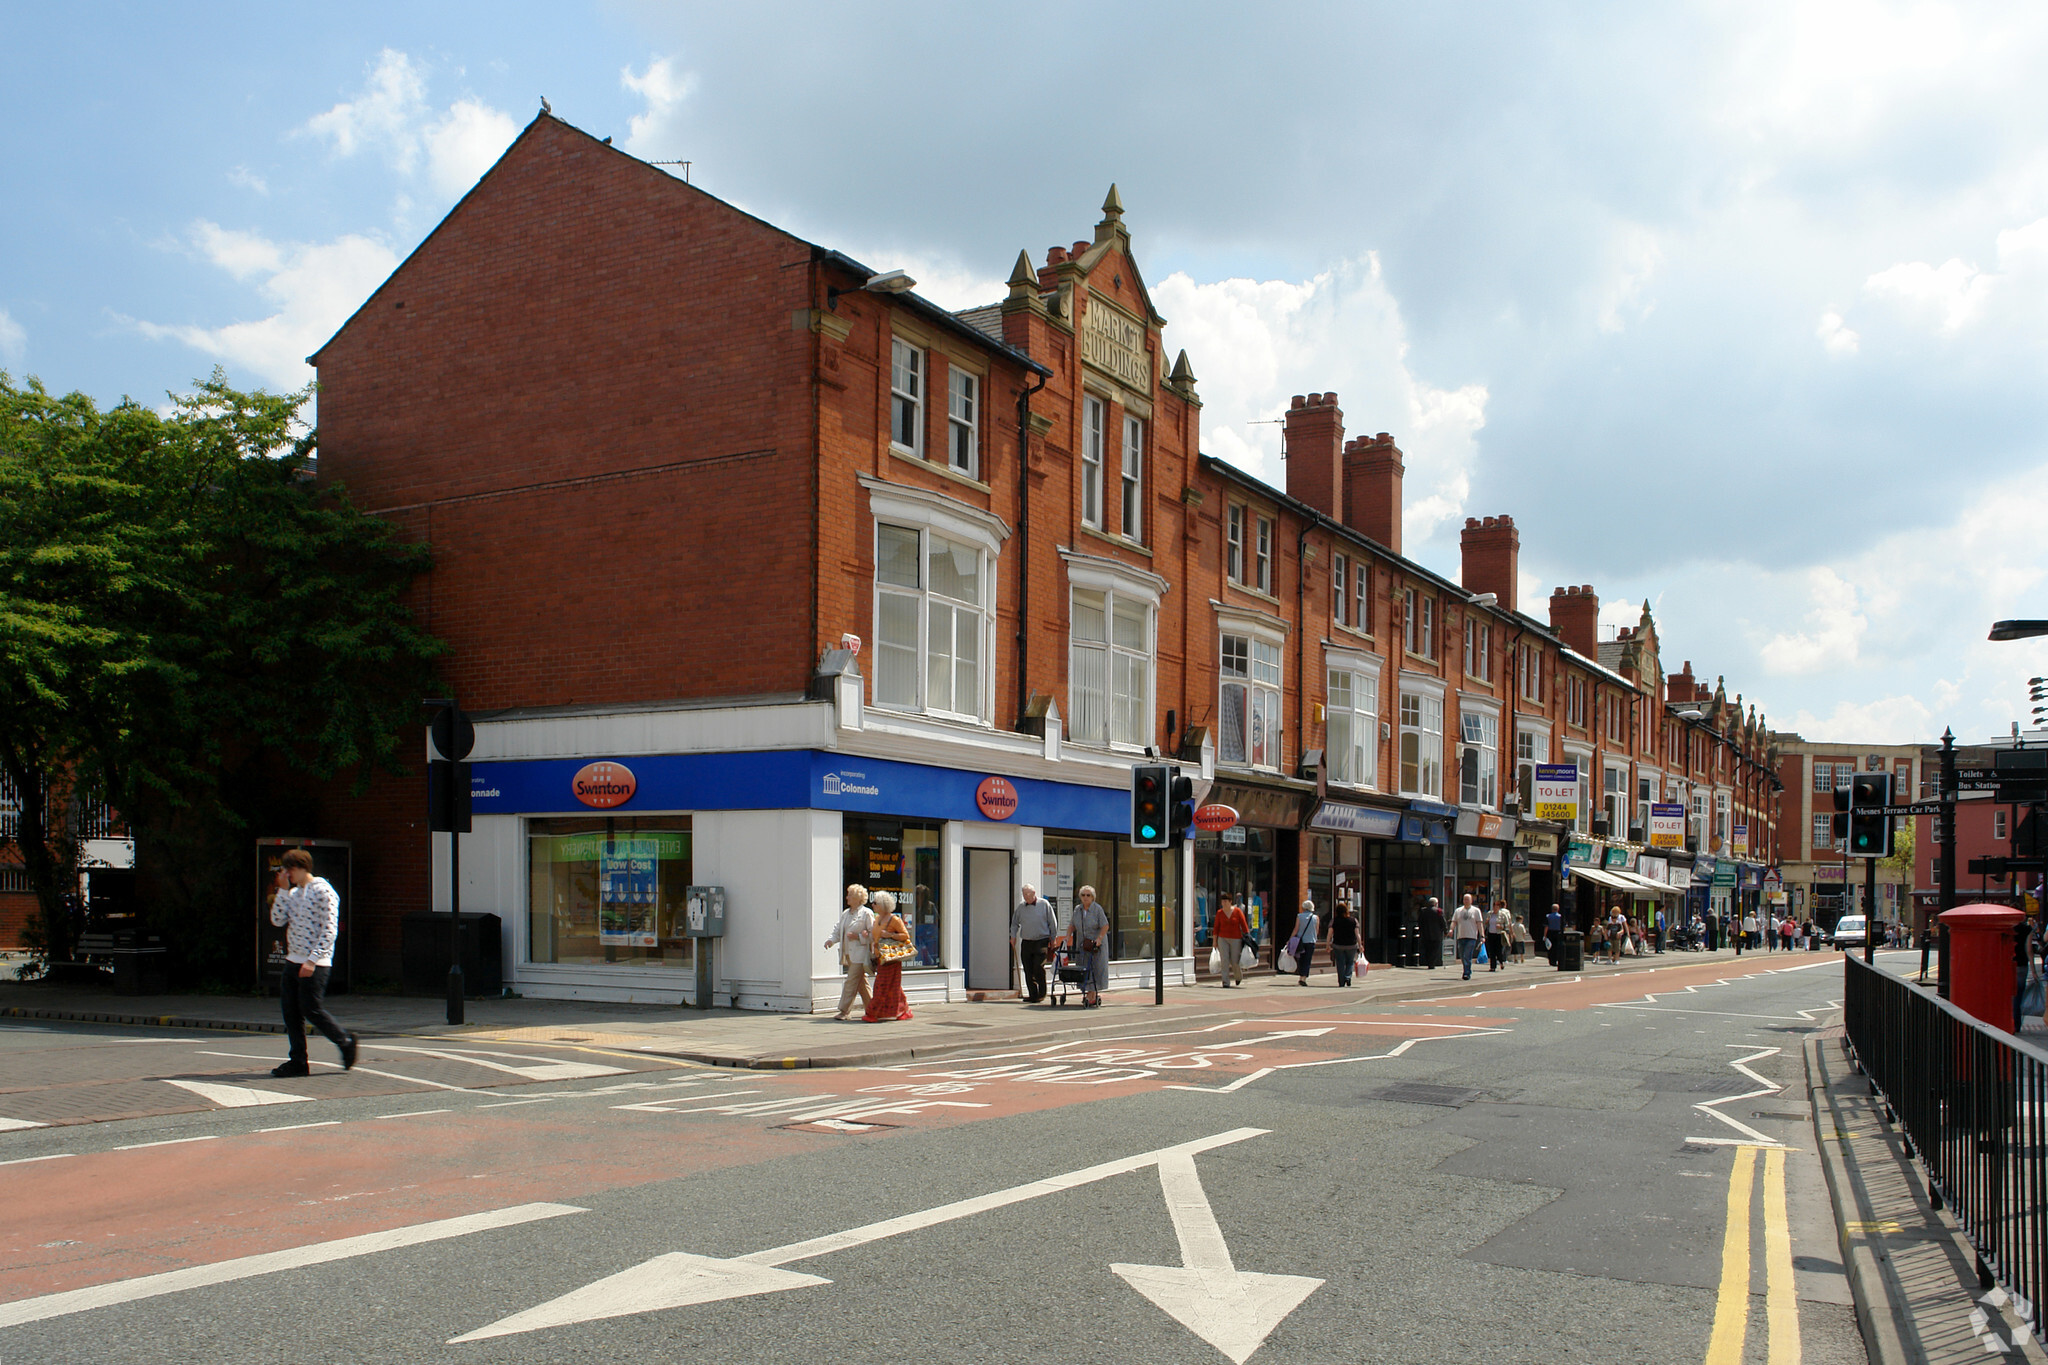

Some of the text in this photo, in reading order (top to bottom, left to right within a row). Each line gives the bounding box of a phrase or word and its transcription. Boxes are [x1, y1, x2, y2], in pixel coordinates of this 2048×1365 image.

[1081, 326, 1148, 389] BUILDINGS
[1958, 770, 1984, 778] Toilets
[576, 780, 630, 796] Swinton
[840, 782, 879, 796] Colonnade
[1958, 781, 2001, 790] Bus Station
[471, 788, 501, 798] onnade
[1539, 787, 1575, 797] TO LET
[981, 791, 1016, 808] Swinton
[1543, 803, 1567, 811] 01244
[1856, 805, 1941, 816] Mesnes Terrace Car Park
[1195, 815, 1234, 824] Swinton
[1320, 804, 1357, 829] KIWI
[1541, 810, 1571, 818] 345600
[1653, 821, 1682, 830] TO LET
[869, 851, 899, 862] Broker of
[606, 859, 652, 871] Low Cost
[869, 862, 896, 873] the year
[1818, 868, 1845, 879] GAM
[1036, 1048, 1254, 1069] BUS
[906, 1063, 1159, 1085] AND
[609, 1090, 992, 1121] LANE
